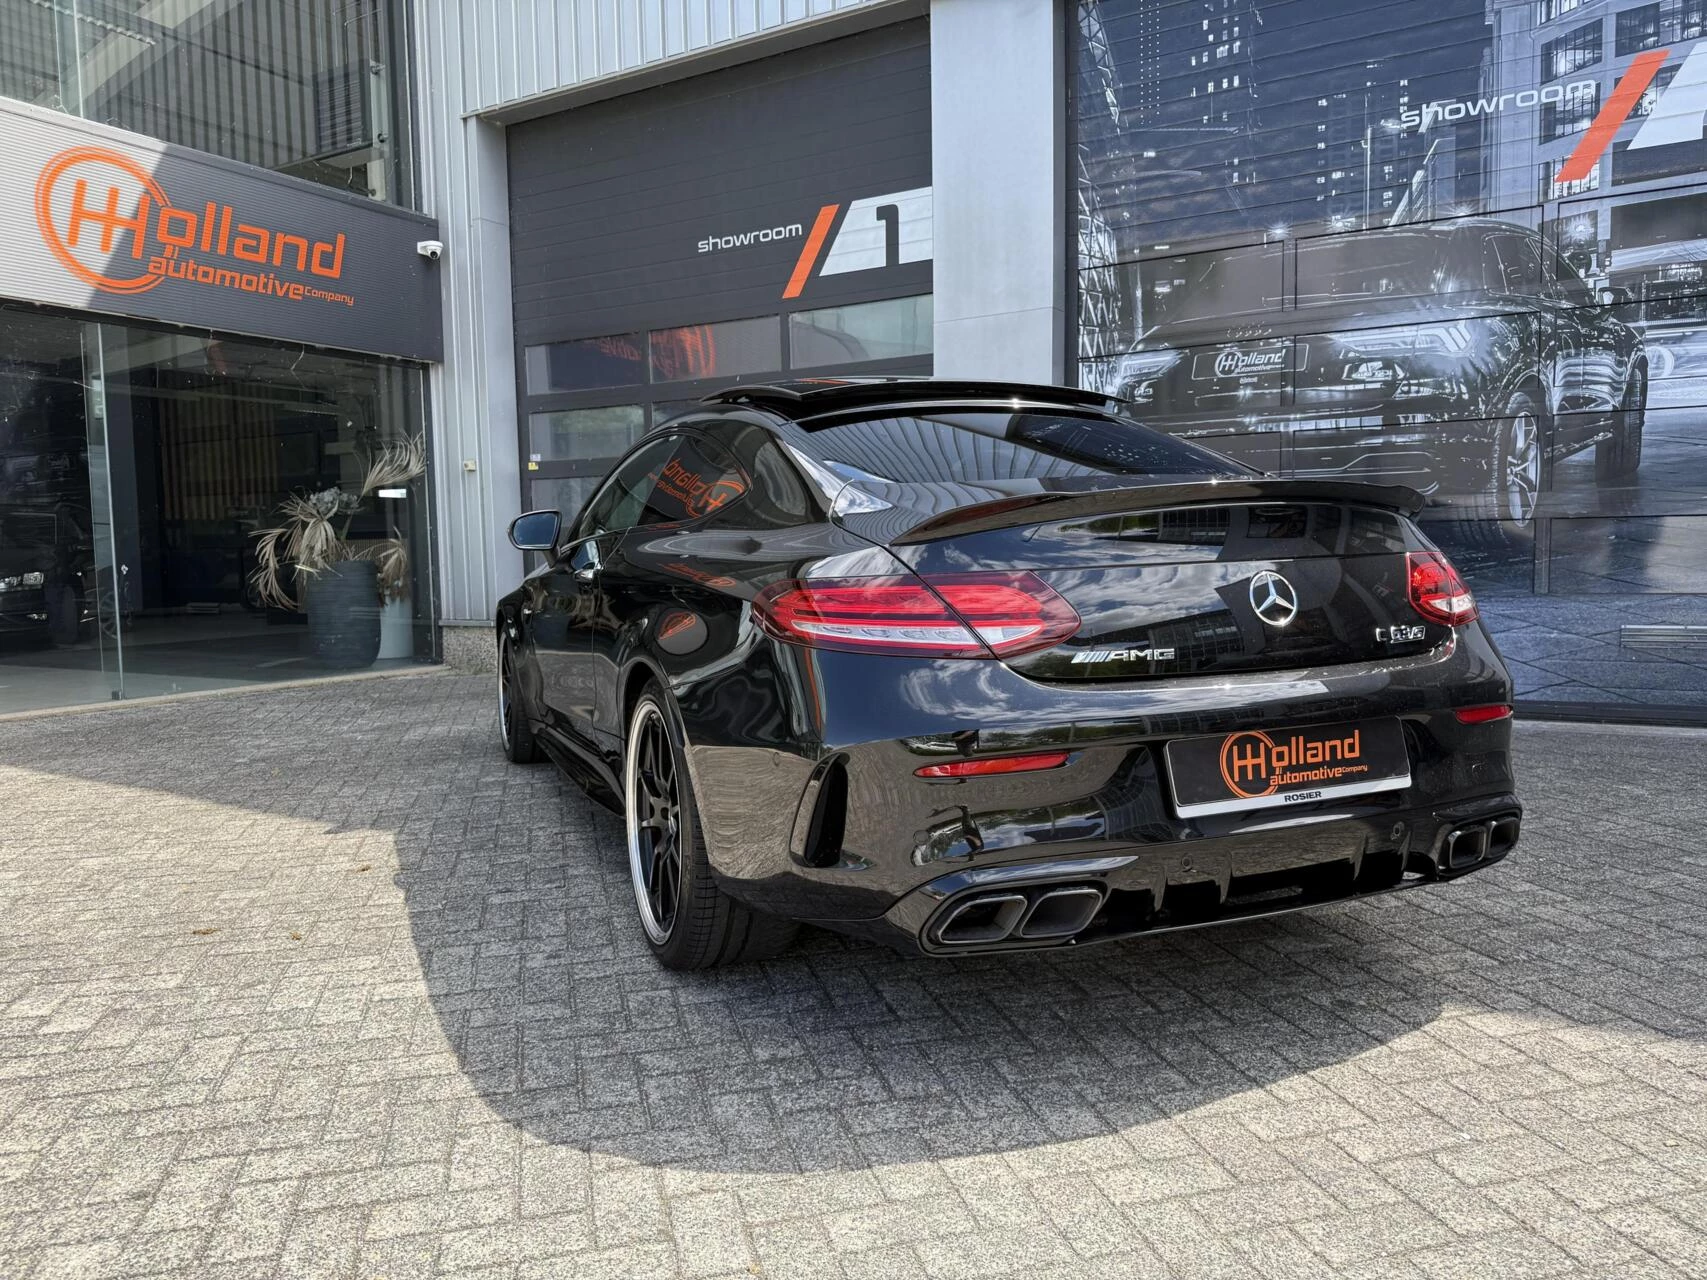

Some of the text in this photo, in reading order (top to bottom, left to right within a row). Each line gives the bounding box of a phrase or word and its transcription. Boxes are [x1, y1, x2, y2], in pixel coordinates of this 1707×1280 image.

[1400, 79, 1597, 127] showroom
[67, 178, 346, 279] Holland
[698, 203, 900, 267] showroom 1
[148, 252, 355, 306] automotive Company
[1232, 729, 1360, 782] Holland
[1269, 766, 1343, 786] automotive
[1284, 790, 1322, 803] ROSIER
